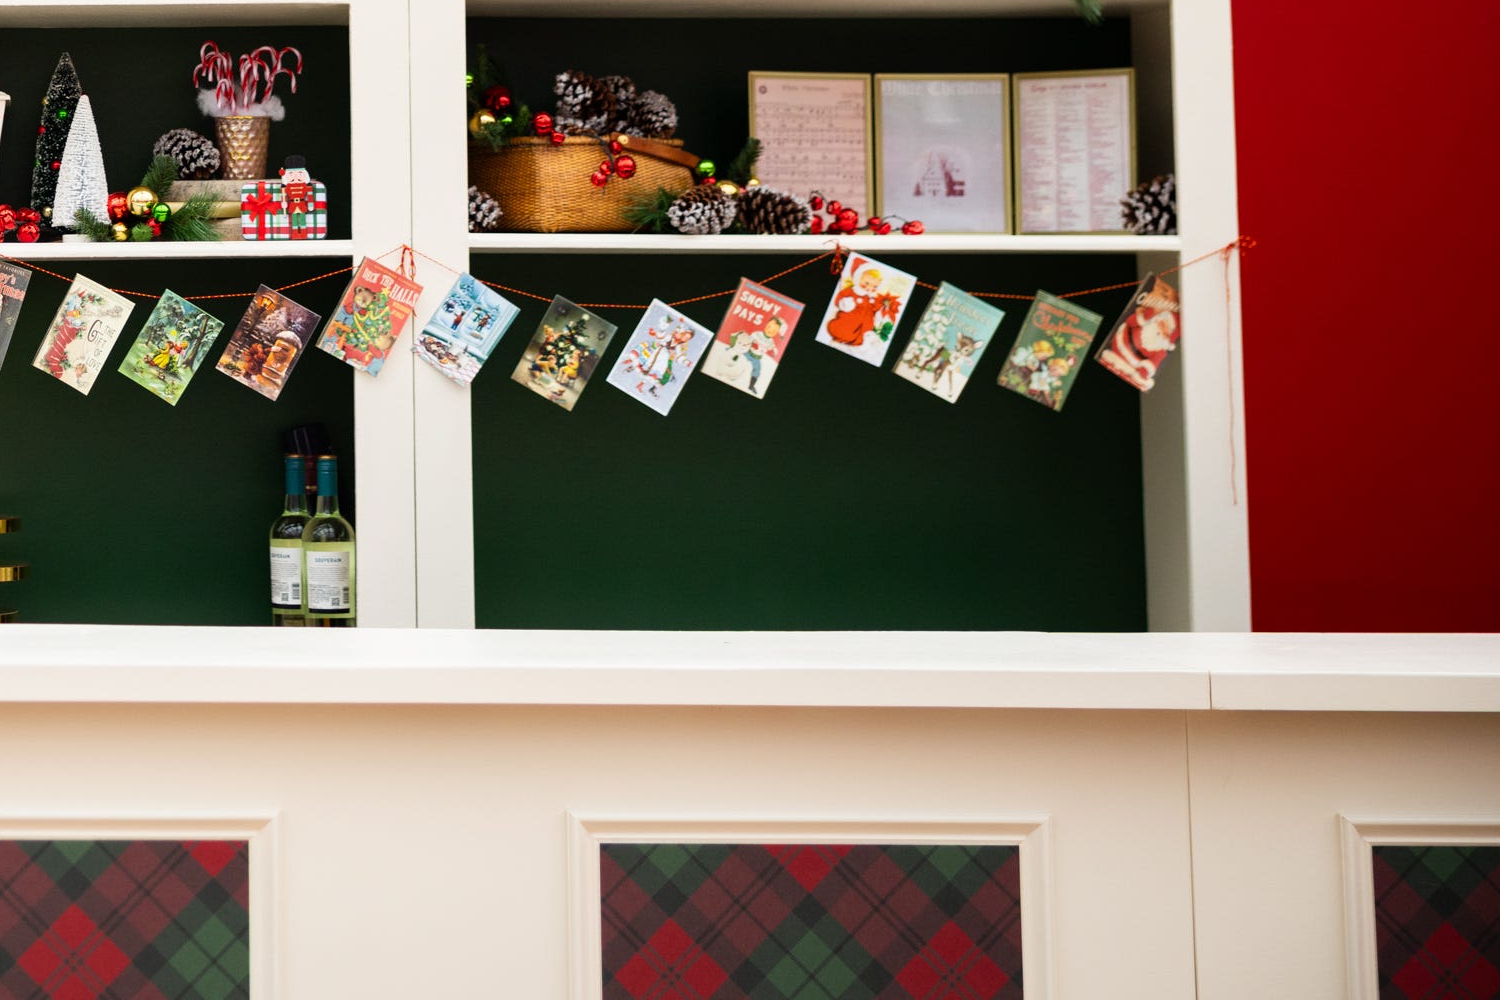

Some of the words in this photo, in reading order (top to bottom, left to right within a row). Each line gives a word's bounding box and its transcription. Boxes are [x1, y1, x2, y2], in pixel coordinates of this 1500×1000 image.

[389, 283, 420, 307] HALLS
[740, 290, 782, 315] SNOWY
[733, 305, 764, 325] DAYS
